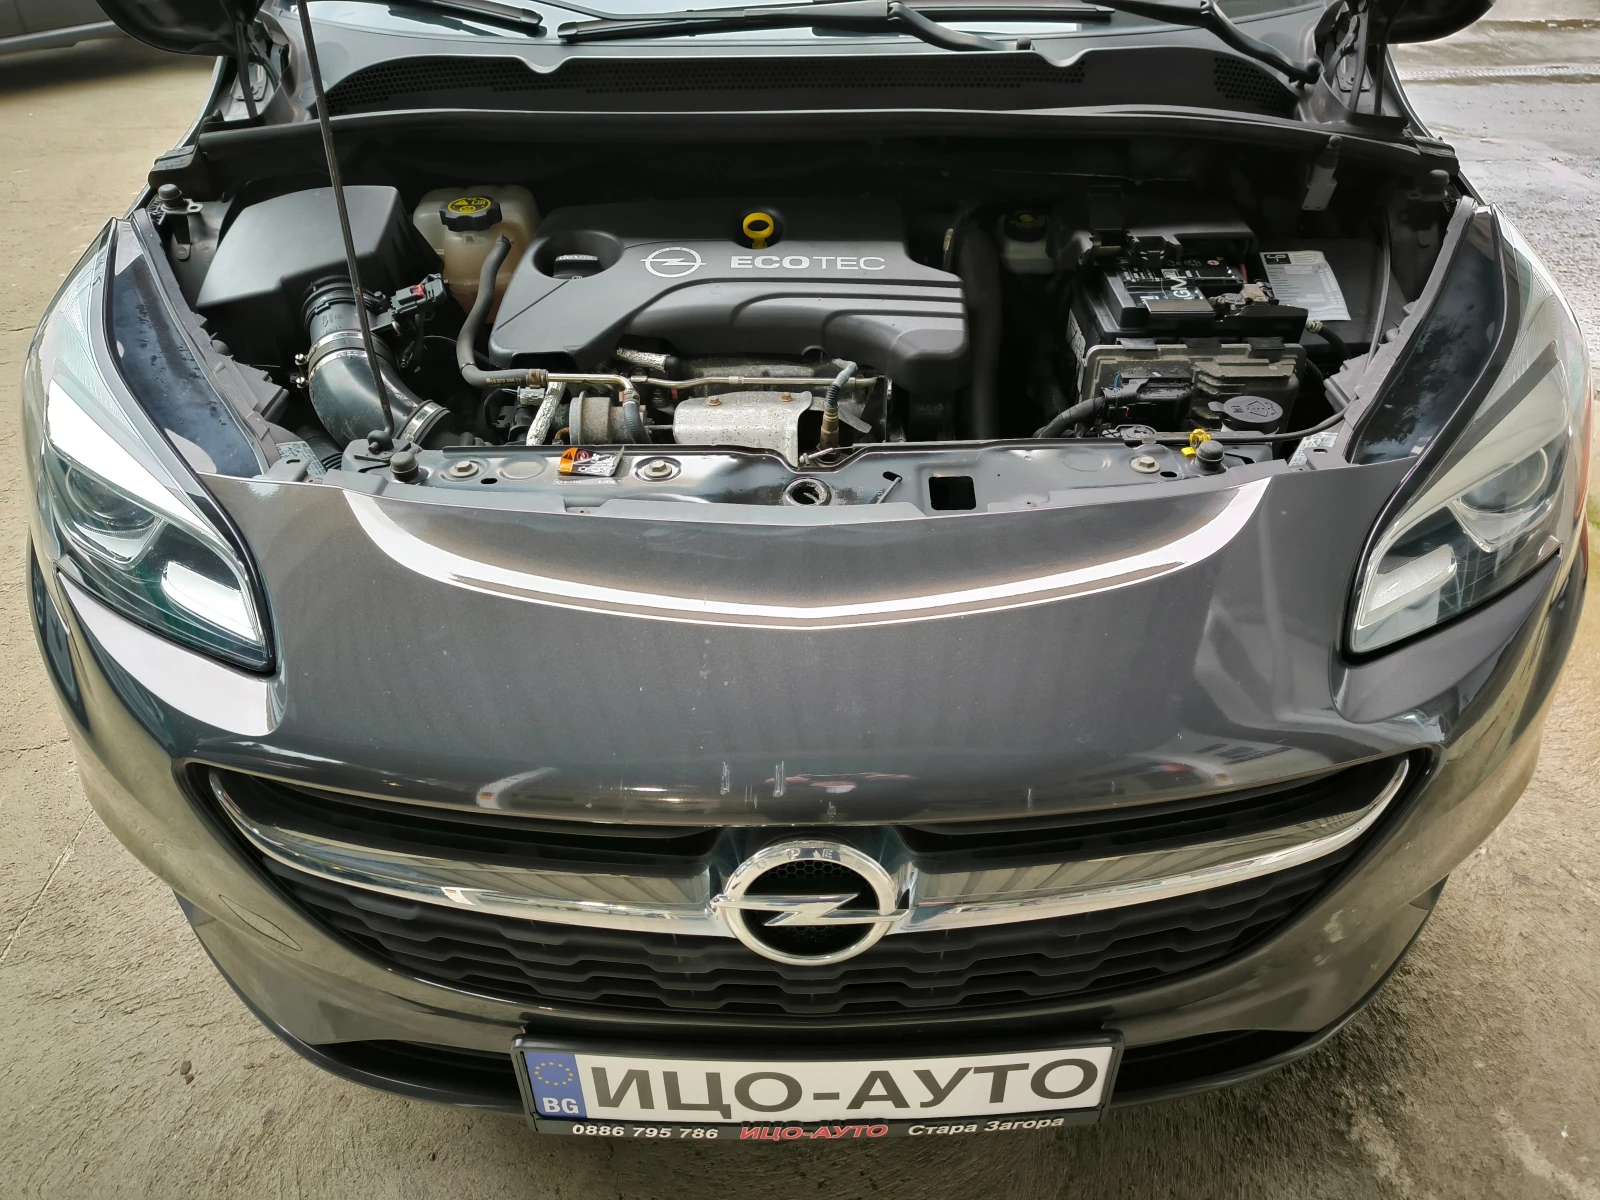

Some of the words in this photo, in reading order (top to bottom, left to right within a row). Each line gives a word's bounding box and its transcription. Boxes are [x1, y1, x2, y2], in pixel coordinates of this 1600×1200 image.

[730, 255, 886, 270] ECOTEC
[1170, 276, 1193, 300] GM
[591, 1058, 1099, 1120] ИЦО-АУТО
[542, 1097, 579, 1114] BG
[572, 1124, 626, 1136] 0886
[632, 1126, 672, 1138] 795
[679, 1127, 719, 1139] 786
[739, 1125, 889, 1141] ИЦО-АУТО
[908, 1121, 977, 1136] Стара
[984, 1117, 1066, 1132] Загора
